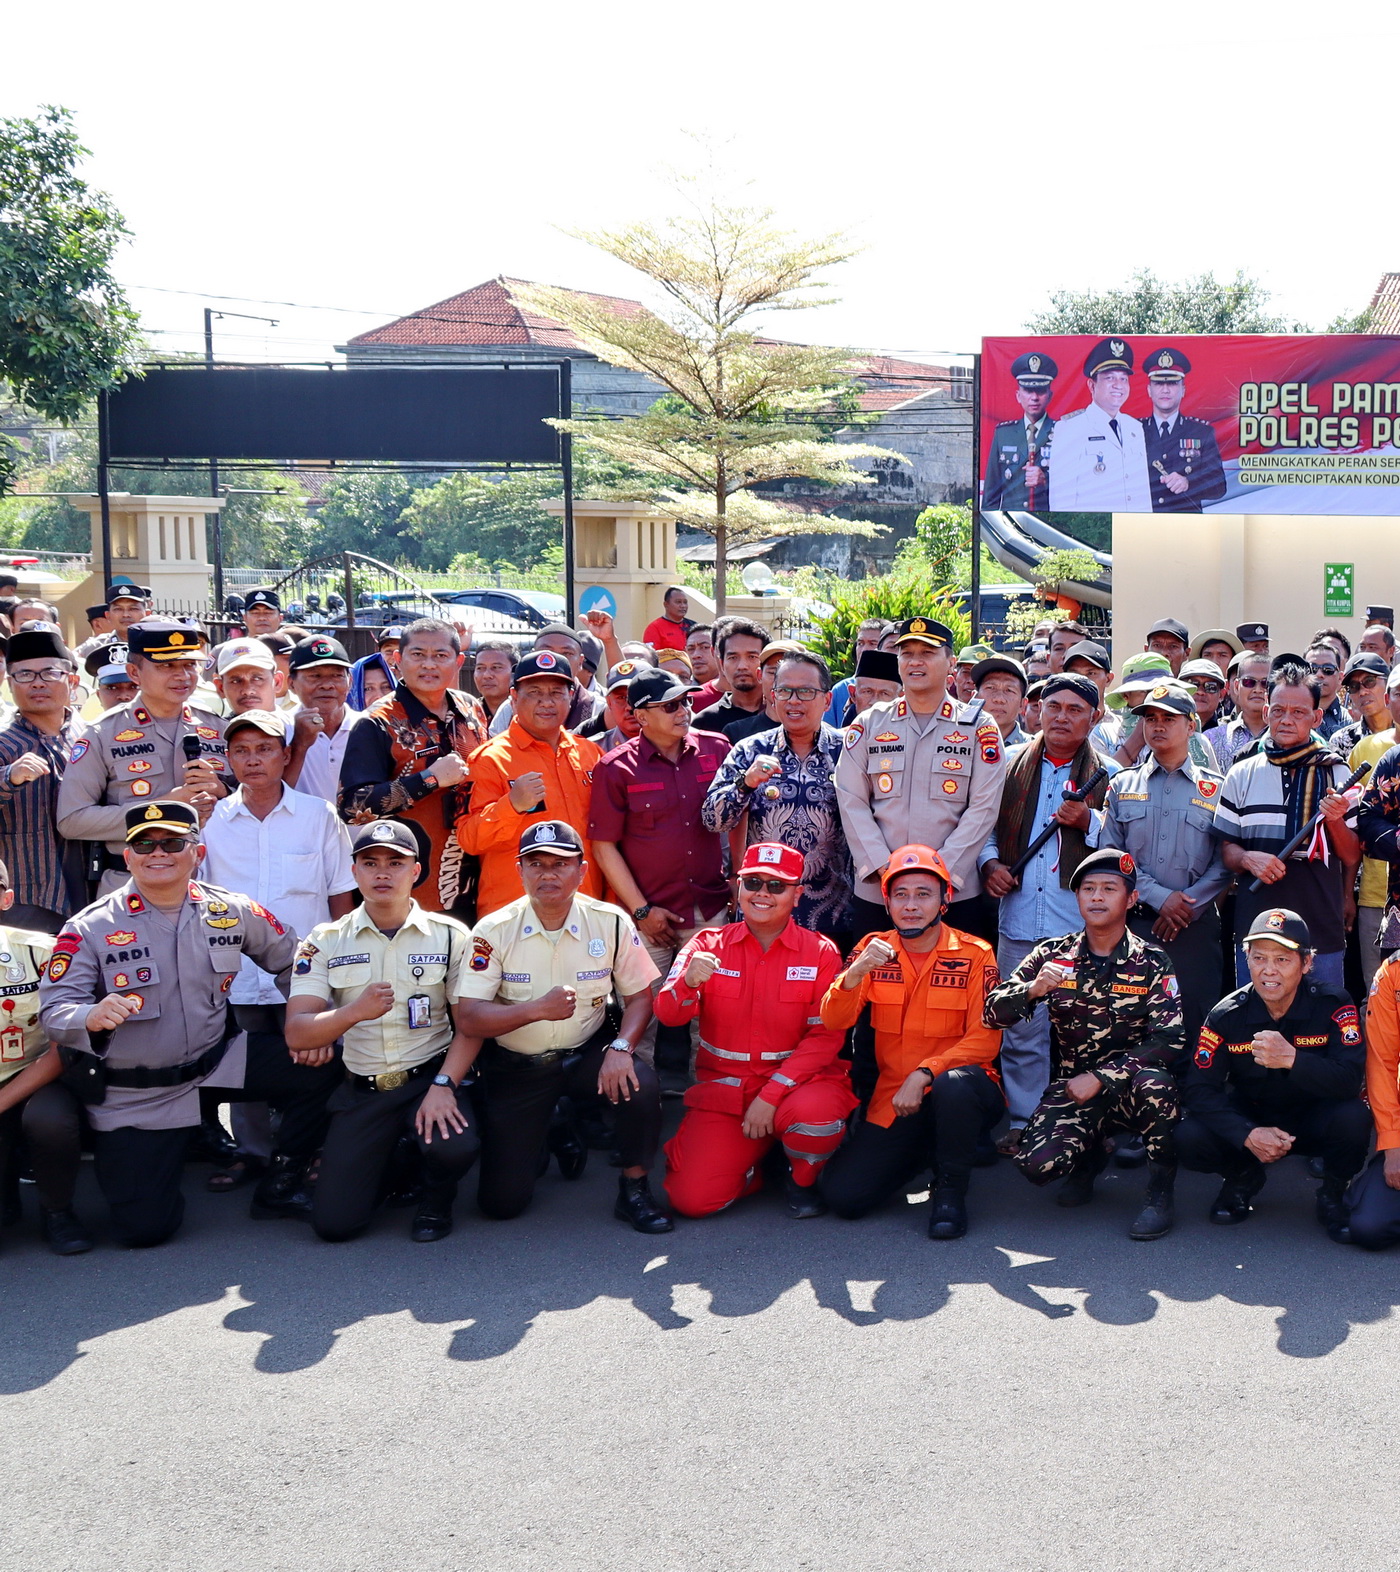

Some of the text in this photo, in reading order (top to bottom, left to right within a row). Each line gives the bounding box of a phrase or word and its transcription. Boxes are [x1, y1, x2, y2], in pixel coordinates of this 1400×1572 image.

[1239, 381, 1319, 415] APEL
[1239, 415, 1361, 449] POLRES
[1240, 456, 1336, 469] MENINGKATKAN
[1337, 457, 1378, 469] PERAN
[1239, 473, 1275, 485] GUNA
[1276, 473, 1362, 485] MENCIPTAKAN
[1326, 599, 1351, 607] TITIK KUMPUL
[110, 743, 155, 759] PUJIONO
[868, 744, 905, 756] RIKI YARIANDI
[937, 745, 971, 756] POLRI
[209, 935, 243, 947] POLRI
[105, 946, 150, 965] ARDI
[411, 954, 448, 964] SATPAM
[871, 970, 902, 981] DIMAS
[934, 975, 965, 986] BPBD
[1113, 985, 1147, 994] BANSER
